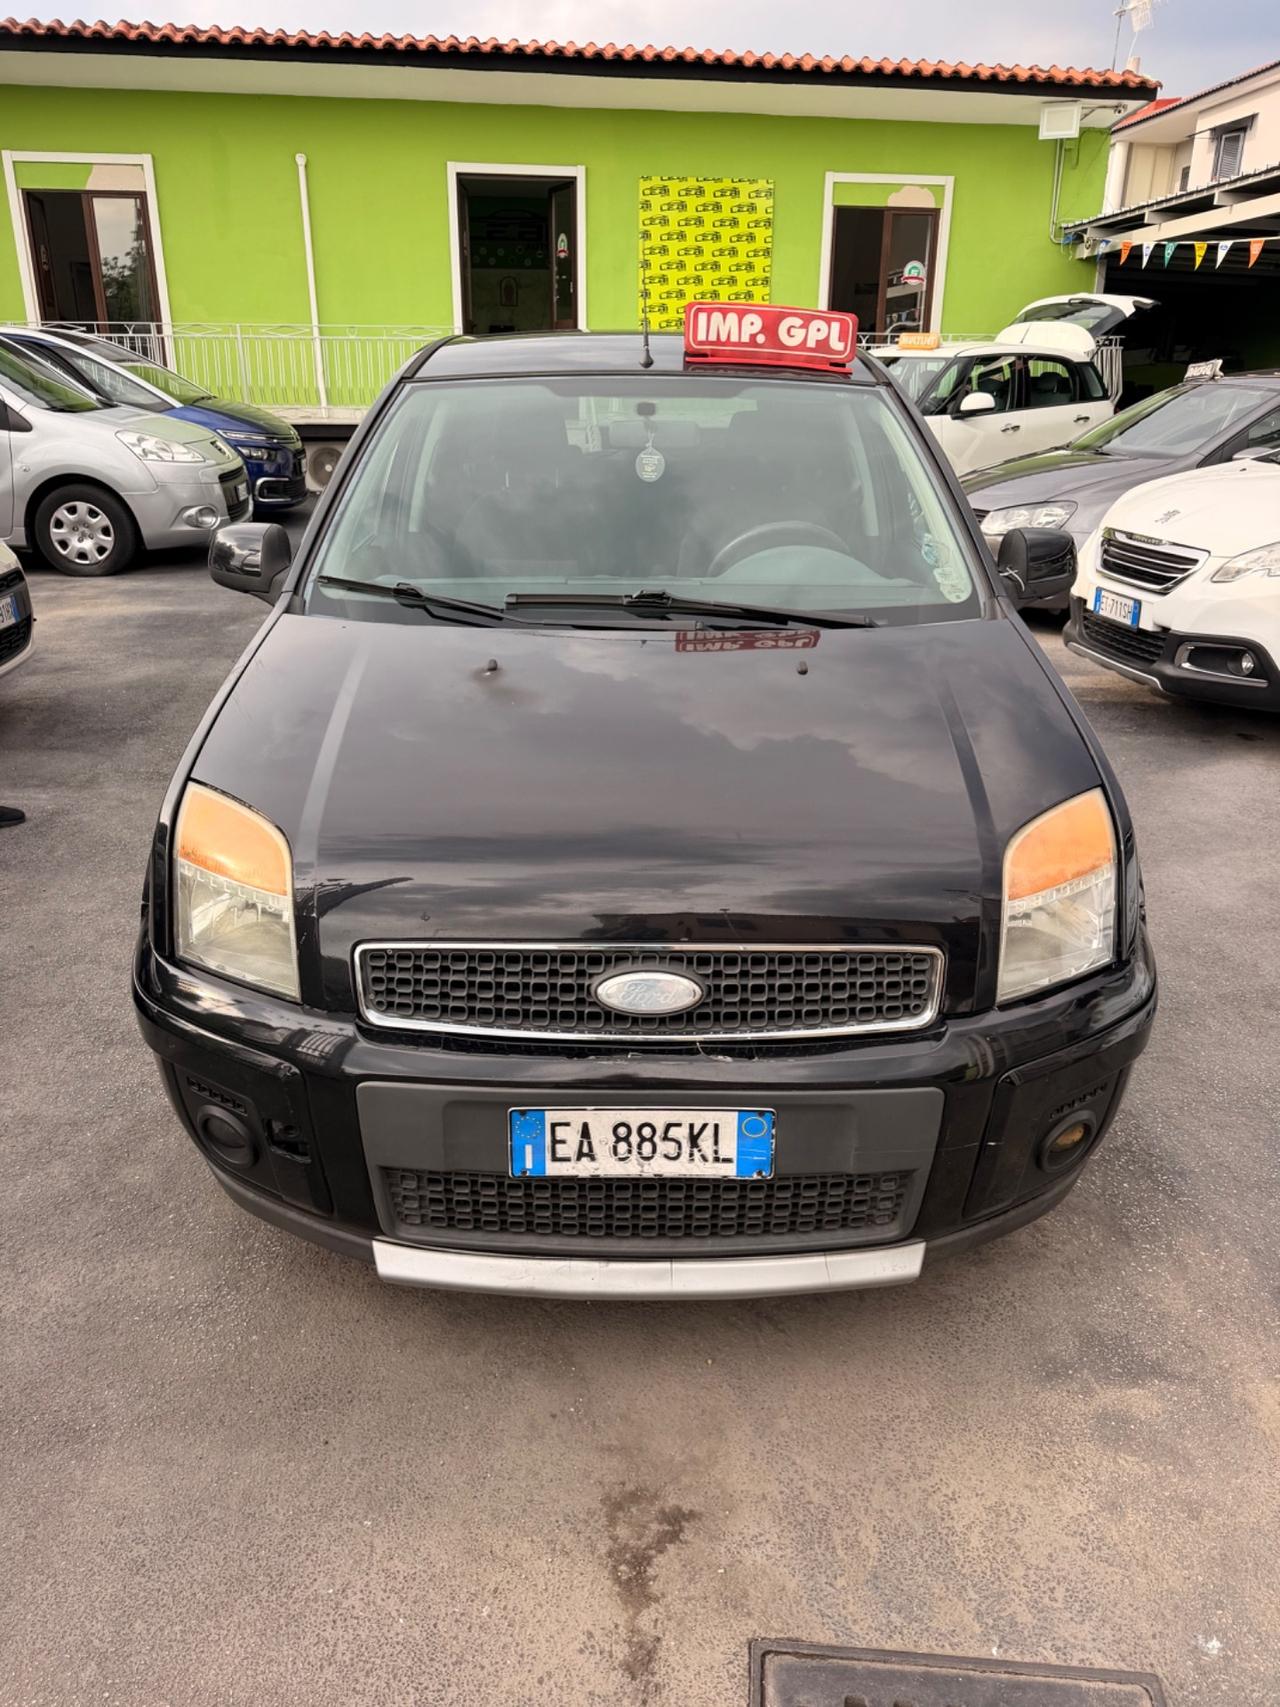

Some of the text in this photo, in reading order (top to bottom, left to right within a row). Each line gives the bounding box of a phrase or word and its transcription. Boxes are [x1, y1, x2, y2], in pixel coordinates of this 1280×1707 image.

[696, 311, 846, 351] IMP. GPL
[549, 1121, 734, 1163] EA 885KL
